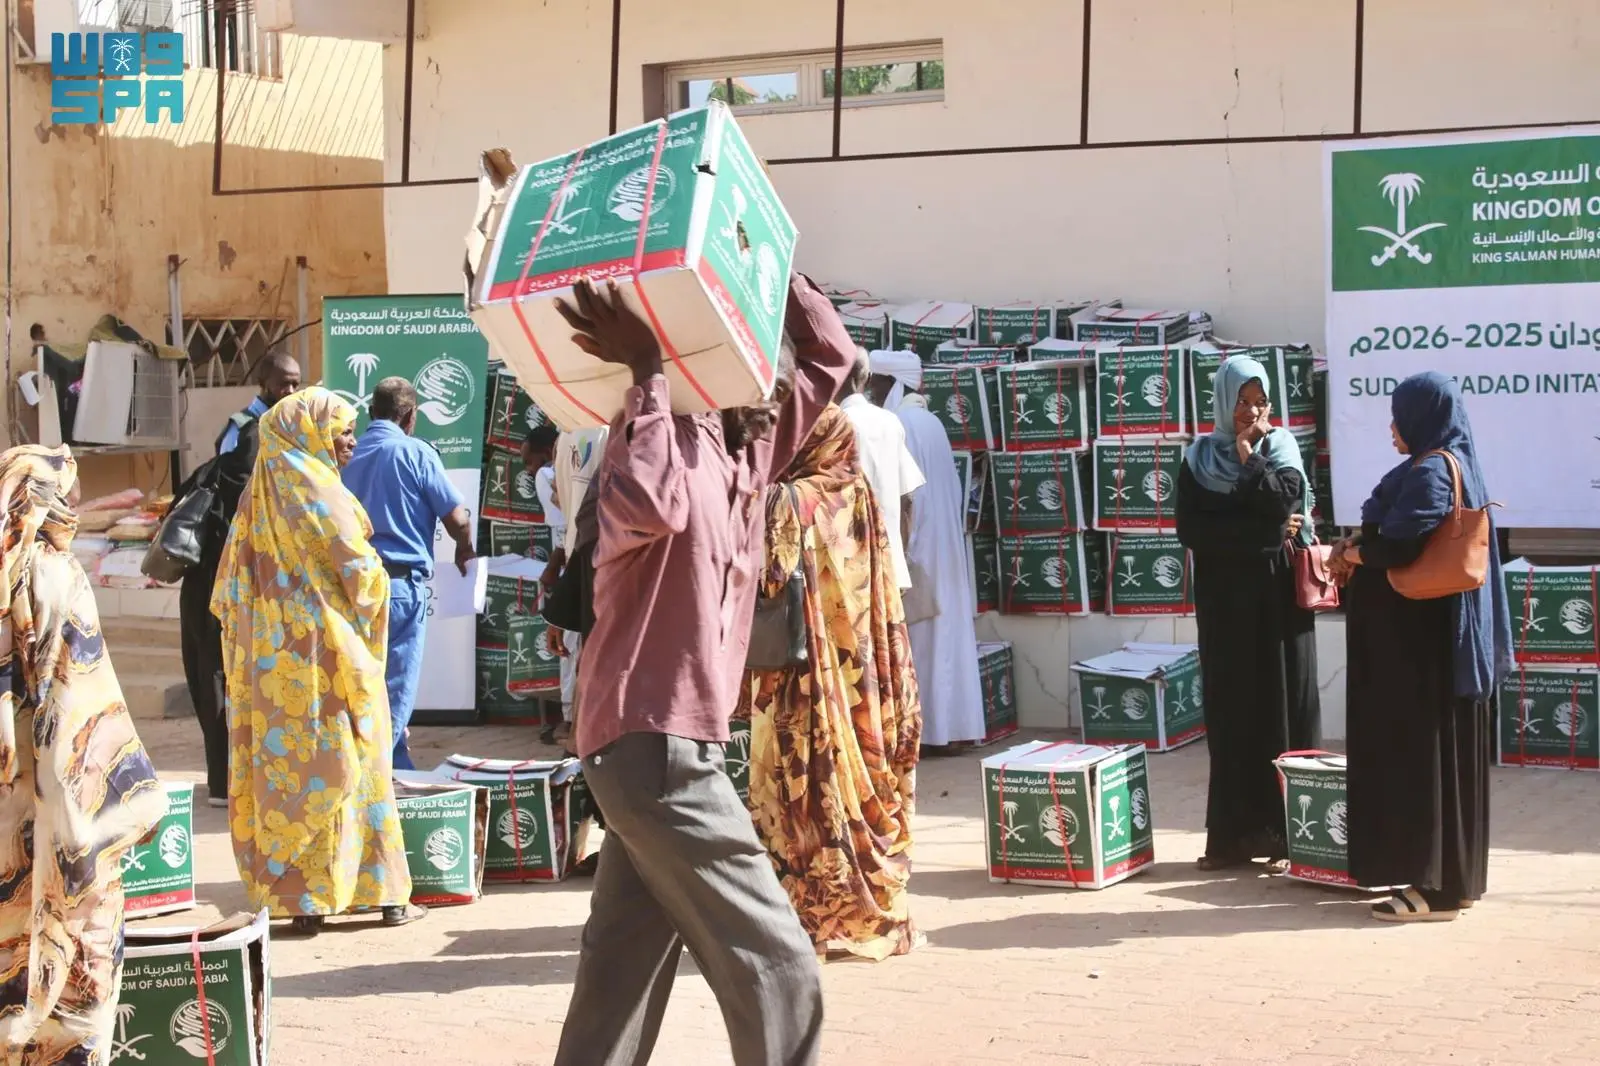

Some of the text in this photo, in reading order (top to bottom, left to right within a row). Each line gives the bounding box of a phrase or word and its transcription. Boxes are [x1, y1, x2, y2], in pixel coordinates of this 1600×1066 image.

[608, 147, 645, 166] SAUDI
[646, 137, 695, 154] AABIA
[1472, 163, 1590, 195] السعودية
[1472, 197, 1582, 221] KINGDOM
[1472, 252, 1503, 264] KING
[1504, 250, 1558, 263] SALMAN
[331, 308, 389, 323] السعودية
[390, 308, 431, 322] العربية
[331, 322, 480, 336] KINGDOM OF SAUDI ARABIA
[1350, 377, 1398, 396] SUD
[1452, 375, 1530, 394] ADAD
[405, 809, 467, 819] OF SAUDI ARABIA
[143, 963, 182, 978] العربية
[139, 980, 153, 990] OF
[156, 977, 188, 989] SAUDI
[190, 973, 230, 985] AABIA
